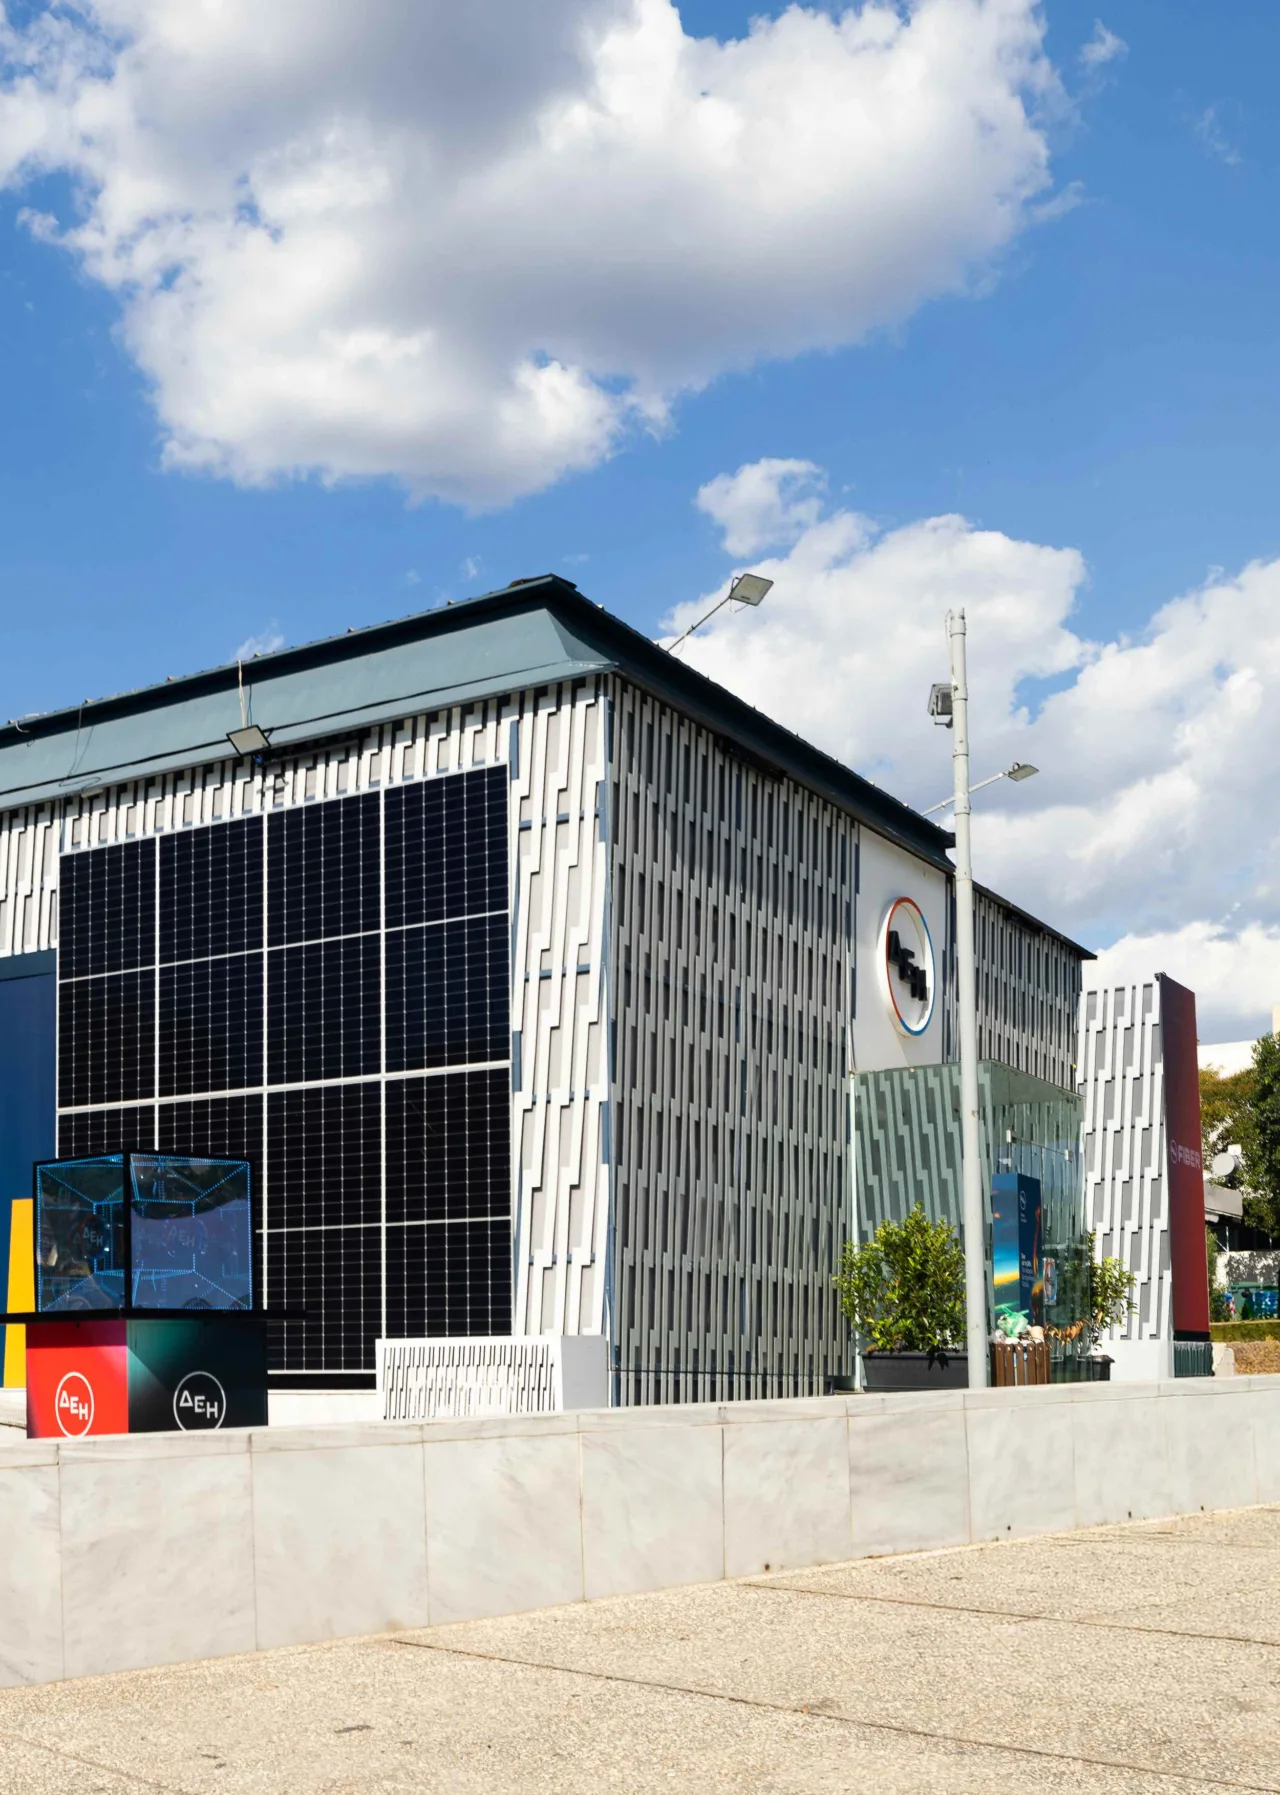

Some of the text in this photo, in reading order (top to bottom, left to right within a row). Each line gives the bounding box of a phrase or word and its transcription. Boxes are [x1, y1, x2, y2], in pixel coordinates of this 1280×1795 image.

[888, 930, 928, 1001] ΔΕΗ
[58, 1389, 89, 1421] ΔΕΗ
[179, 1389, 219, 1419] ΔΕΗ
